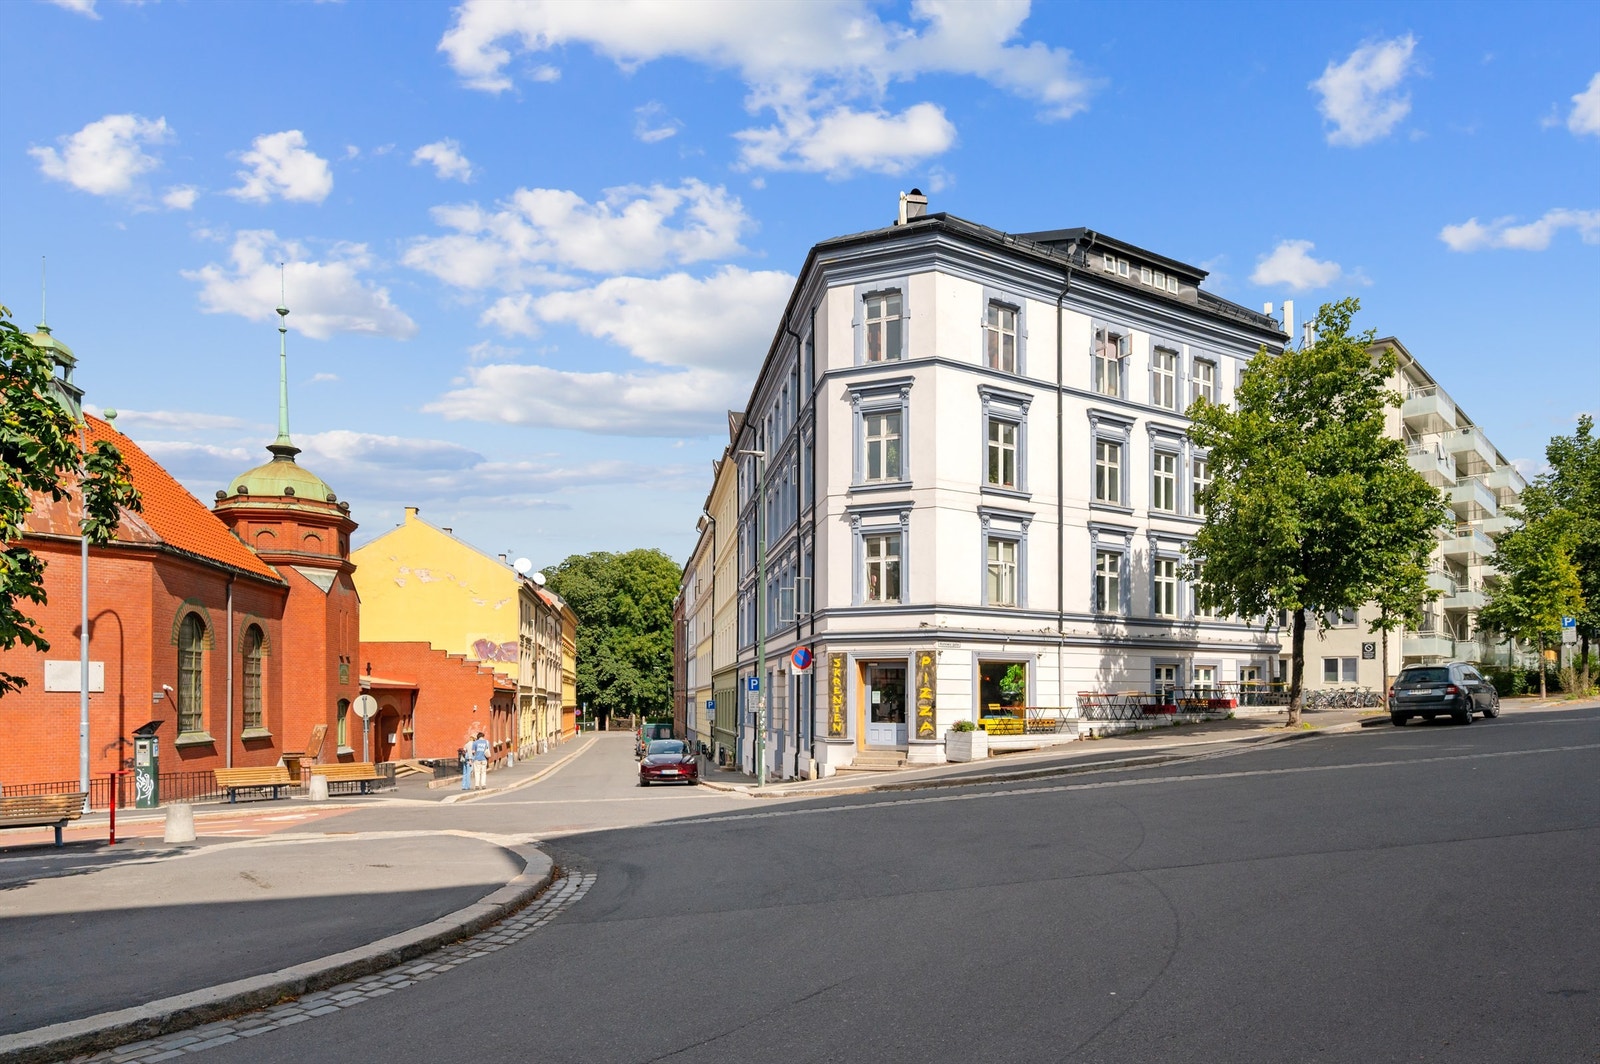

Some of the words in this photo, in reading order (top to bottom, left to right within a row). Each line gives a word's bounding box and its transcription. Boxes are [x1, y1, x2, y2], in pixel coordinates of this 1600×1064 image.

[1564, 617, 1572, 626] P
[750, 679, 758, 690] P
[832, 658, 843, 731] SKRENTEN
[918, 655, 934, 733] PIZZA
